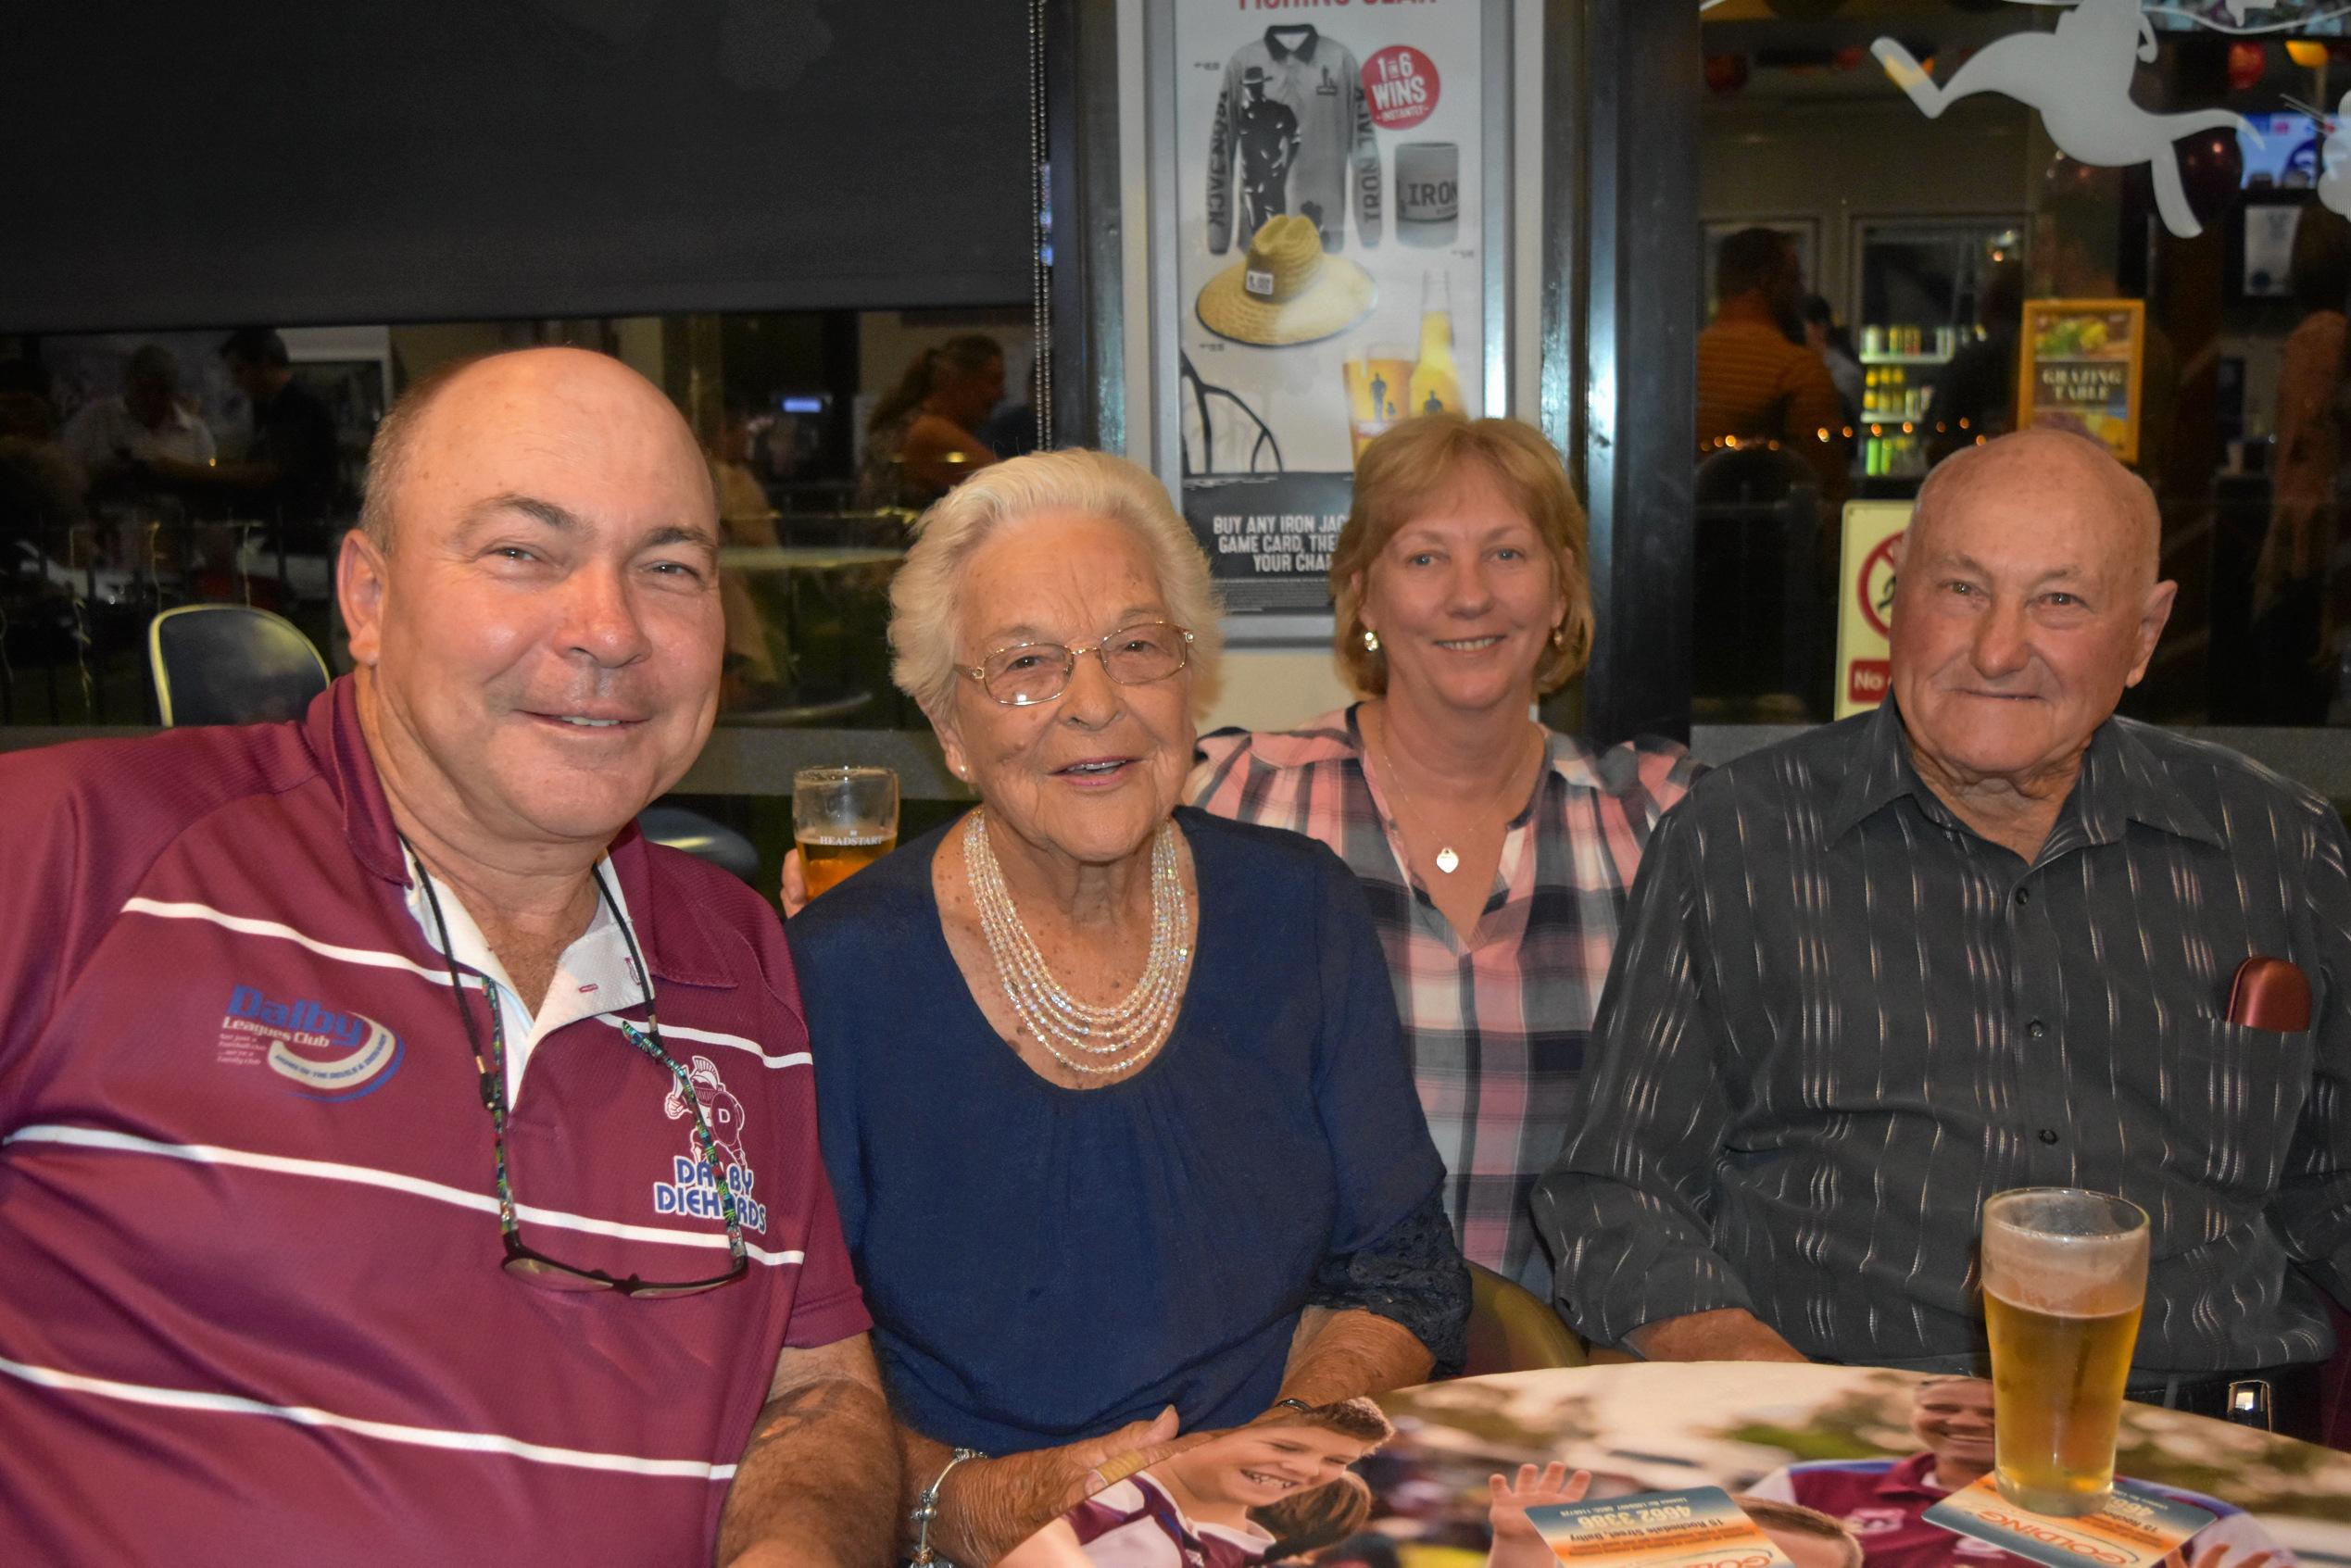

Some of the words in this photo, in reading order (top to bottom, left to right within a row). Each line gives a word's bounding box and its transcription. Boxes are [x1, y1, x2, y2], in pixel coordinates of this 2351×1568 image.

[1378, 56, 1388, 82] 1
[1399, 52, 1414, 79] 6
[1371, 75, 1427, 111] WINS
[1360, 158, 1380, 224] IRON
[2043, 368, 2122, 385] GRAZING
[2055, 383, 2110, 401] TABLE
[1213, 515, 1242, 534] BUY
[1246, 515, 1276, 534] ANY
[1279, 515, 1315, 534] IRON
[1318, 515, 1346, 533] JAC
[1218, 534, 1260, 554] GAME
[1262, 534, 1304, 555] CARD,
[1308, 534, 1338, 553] THE
[1252, 553, 1292, 572] YOUR
[1854, 670, 1883, 691] No
[228, 985, 364, 1047] Dalby
[221, 1016, 291, 1040] Leagues
[293, 1031, 331, 1048] Club
[718, 1109, 732, 1124] D
[675, 1157, 754, 1195] DABY
[654, 1184, 767, 1235] DIEHRDS
[1635, 1504, 1691, 1524] 4662
[2107, 1498, 2156, 1518] 466
[1707, 1518, 1724, 1528] 15
[2143, 1523, 2159, 1534] 15
[1569, 1532, 1603, 1545] Dalby
[1603, 1527, 1644, 1540] Street,
[1975, 1511, 2128, 1565] GOLDING
